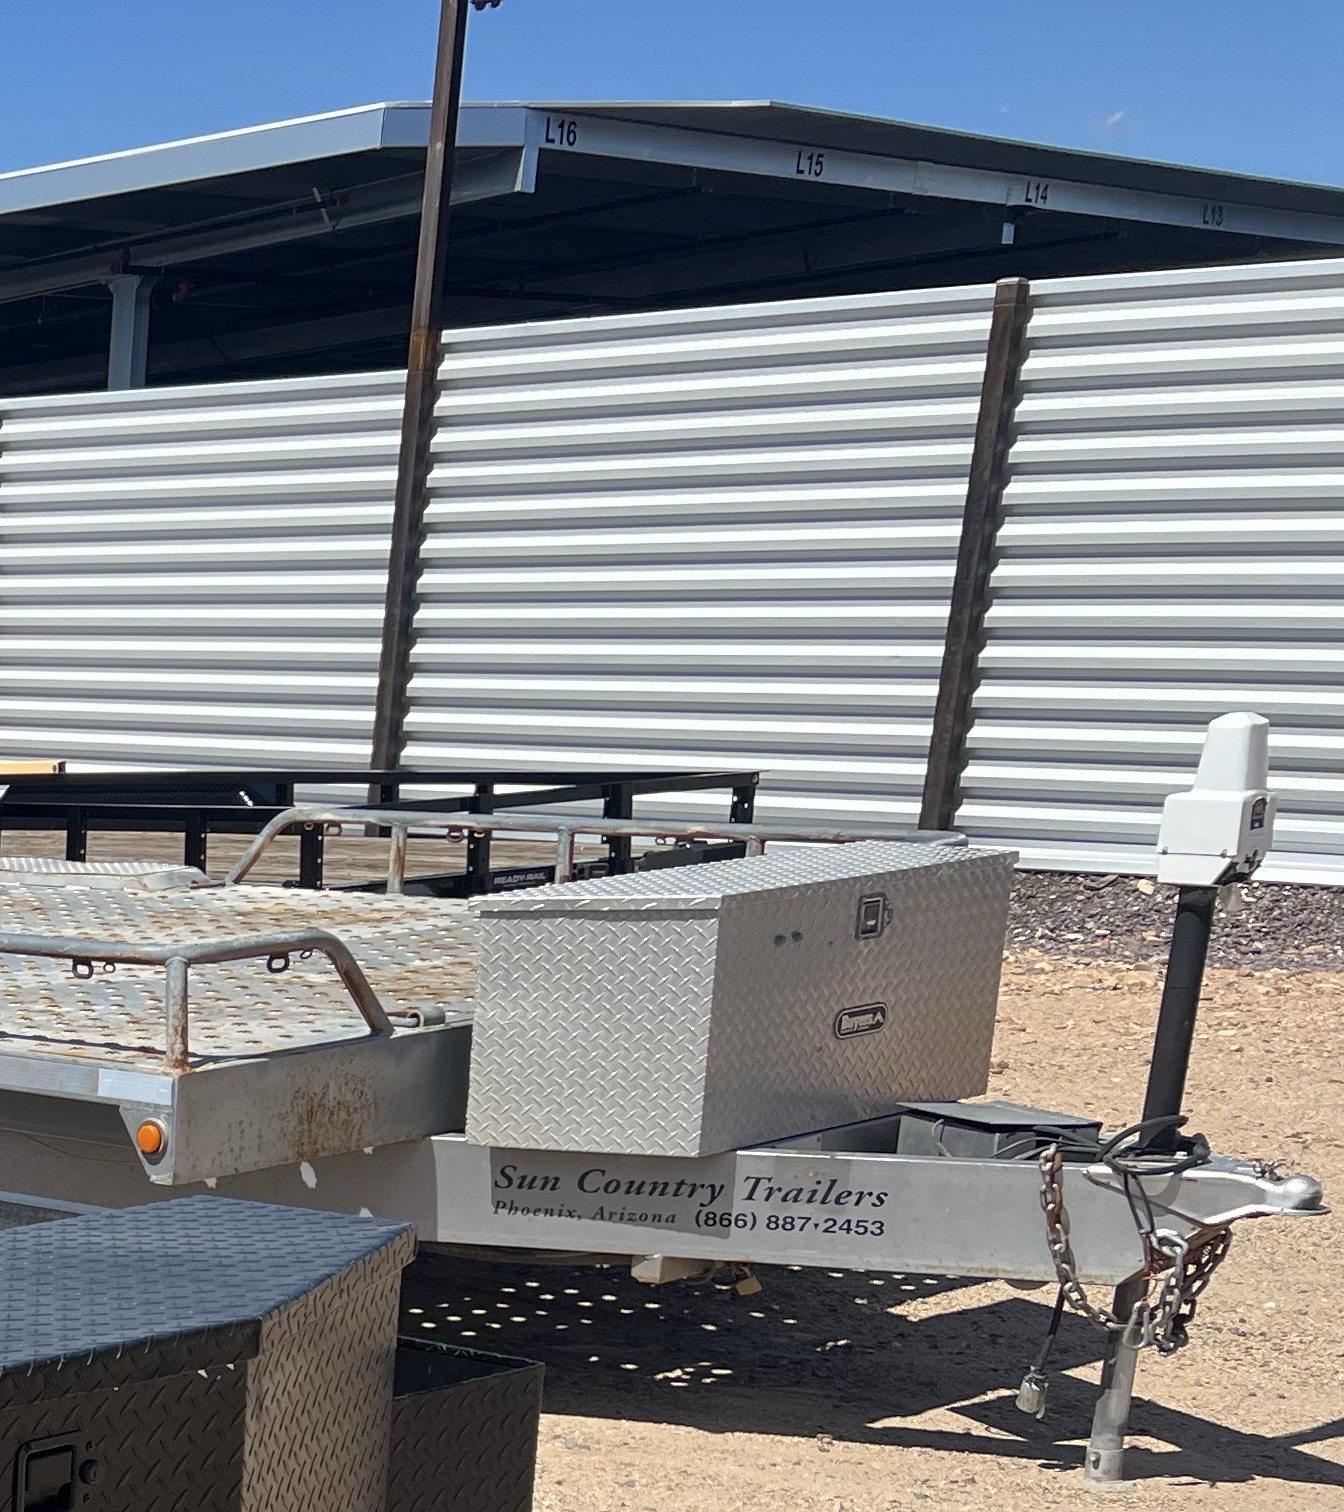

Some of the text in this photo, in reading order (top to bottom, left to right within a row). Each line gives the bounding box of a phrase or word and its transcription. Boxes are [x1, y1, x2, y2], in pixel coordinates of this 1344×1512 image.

[544, 116, 578, 147] L16
[795, 150, 825, 177] L15
[1024, 180, 1049, 205] L14
[1202, 205, 1226, 226] L13
[494, 1164, 889, 1208] Sun Country Trailers
[492, 1200, 582, 1221] Phoenix,
[590, 1205, 678, 1225] Arizona
[694, 1209, 758, 1231] (866)
